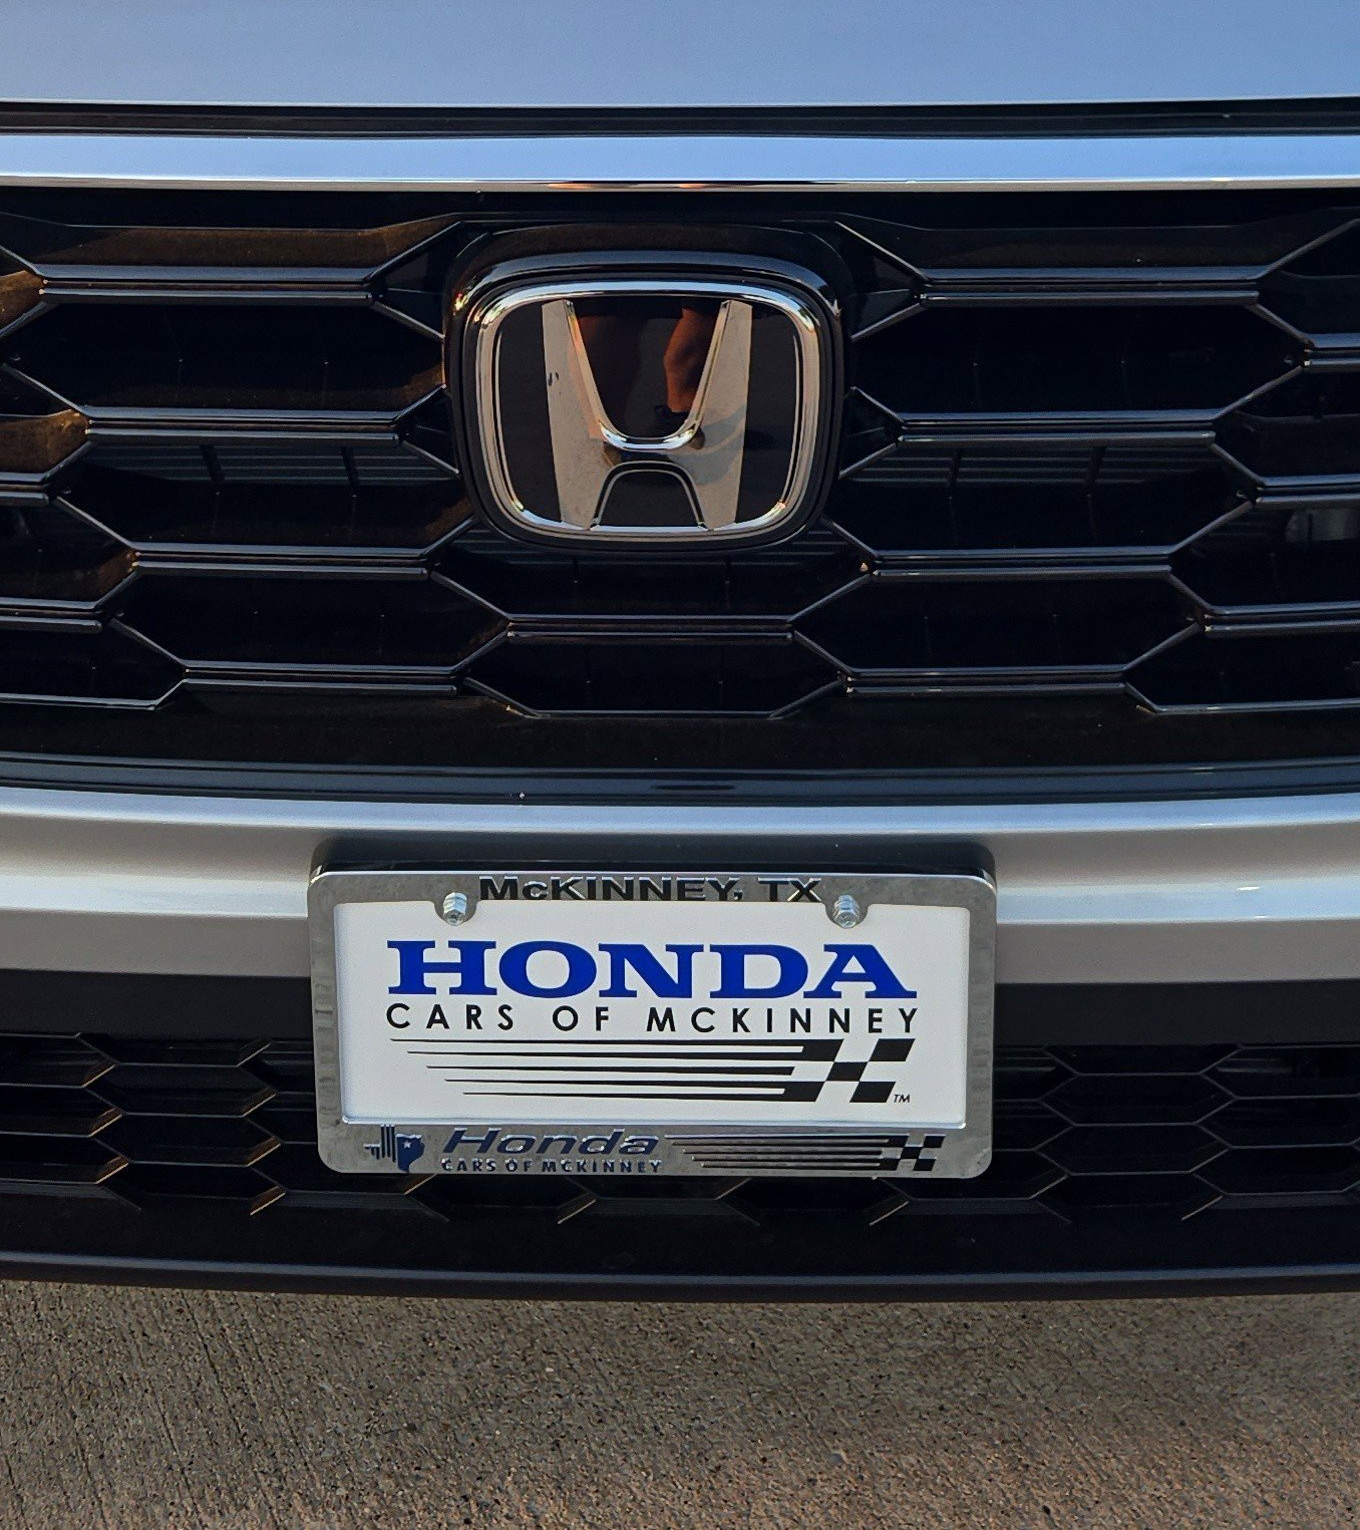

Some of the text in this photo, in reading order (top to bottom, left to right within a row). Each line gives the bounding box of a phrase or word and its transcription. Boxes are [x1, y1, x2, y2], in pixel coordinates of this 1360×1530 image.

[478, 875, 822, 902] McKINNEY, TX
[387, 940, 917, 999] HONDA
[386, 1002, 919, 1033] CARS OF MCKINNEY
[441, 1127, 660, 1155] Honda
[440, 1157, 663, 1174] CARS OF MCKINNEY
